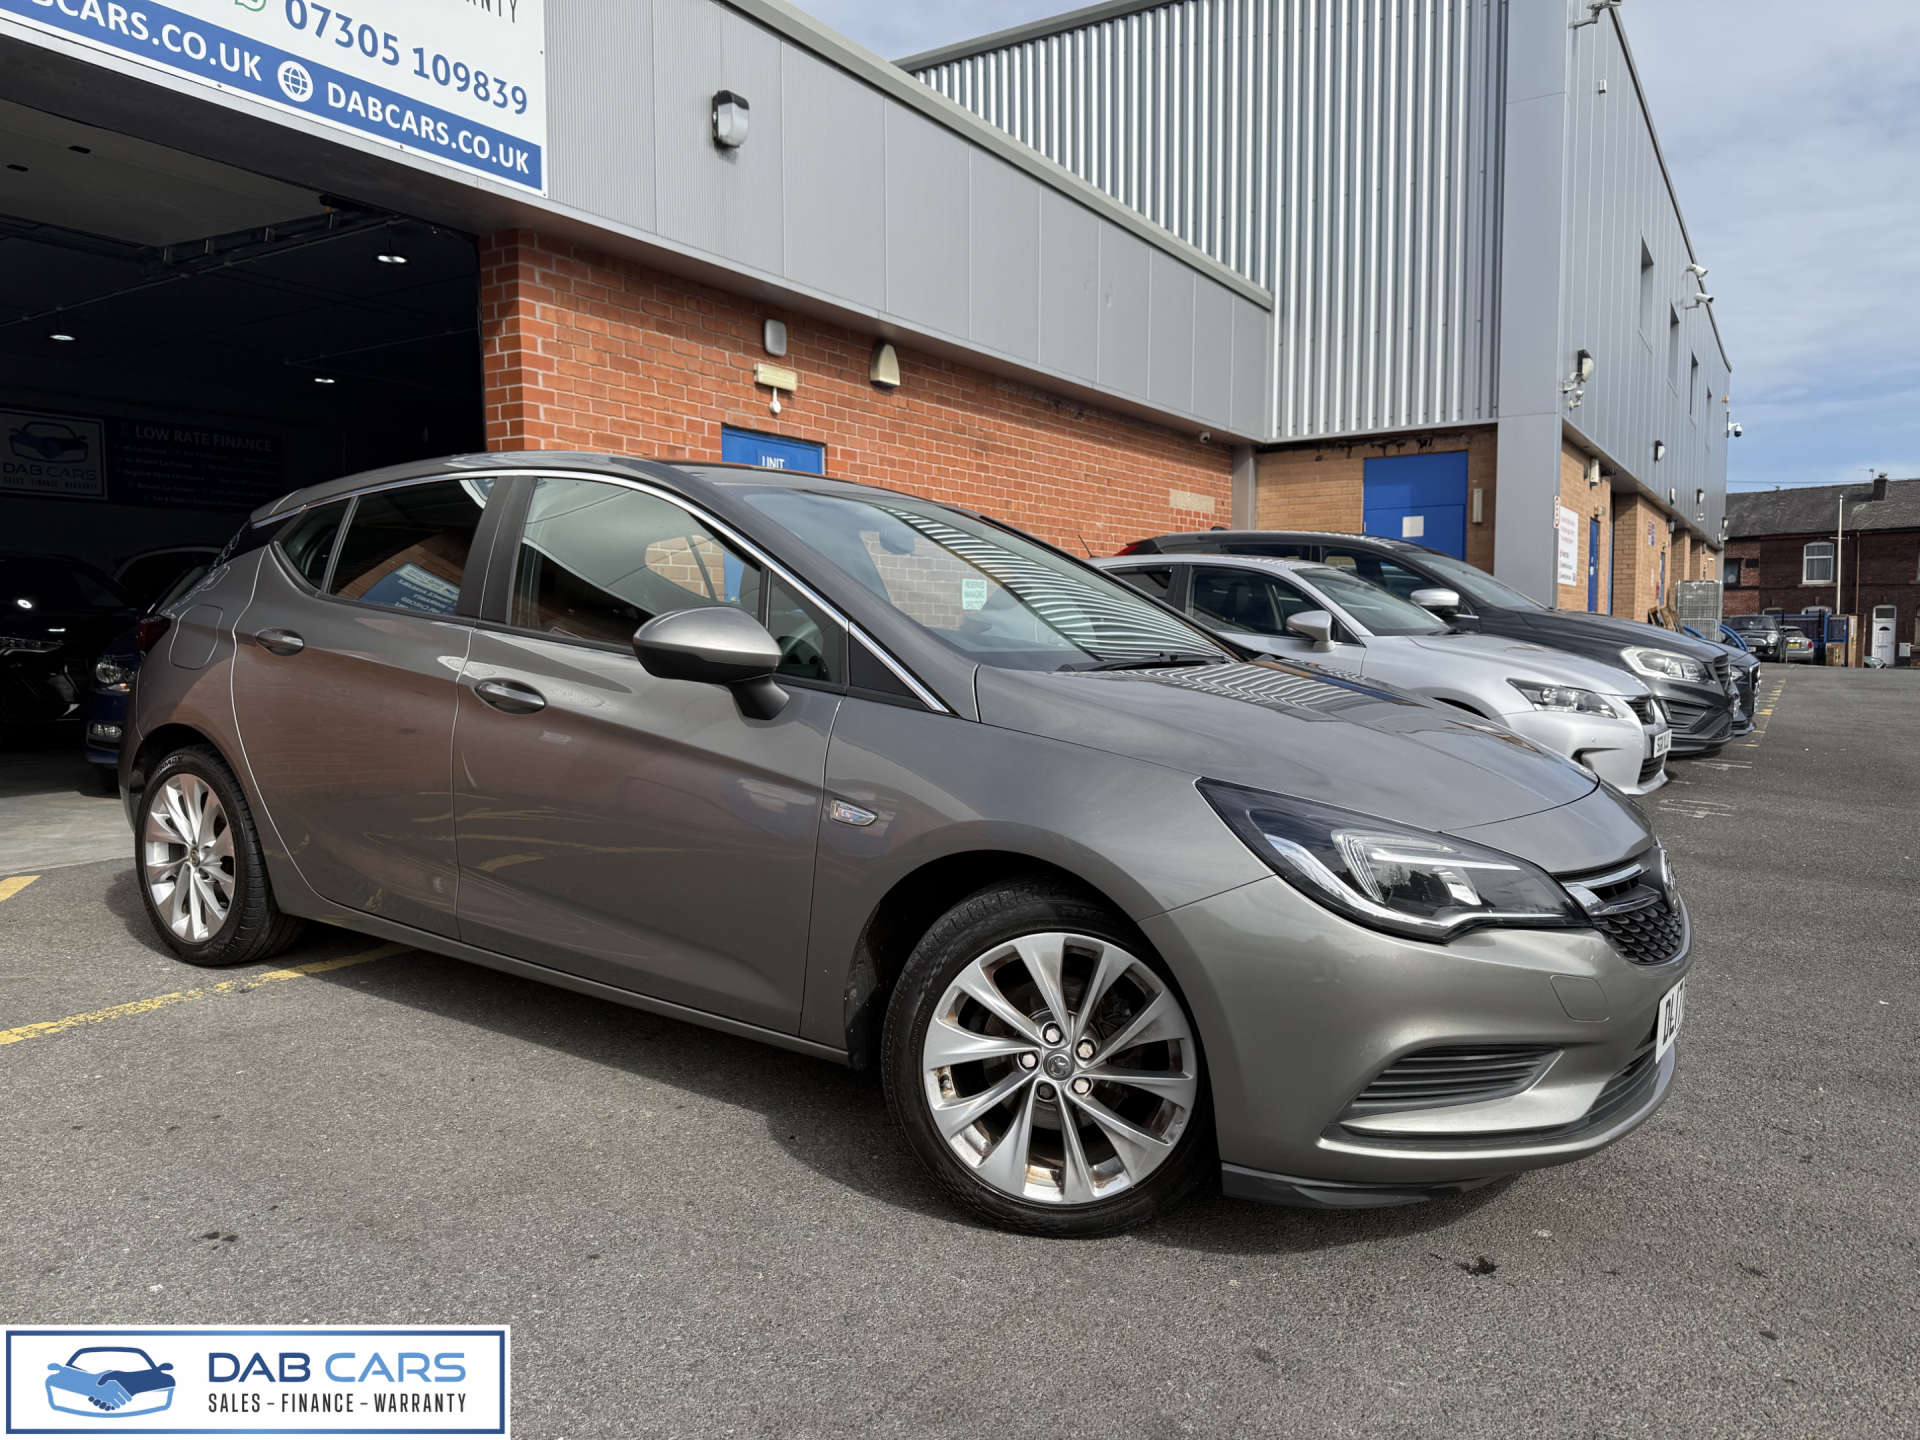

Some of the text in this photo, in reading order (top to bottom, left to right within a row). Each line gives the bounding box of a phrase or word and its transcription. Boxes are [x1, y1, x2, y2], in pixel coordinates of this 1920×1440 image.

[32, 0, 262, 81] CARS.CO.UK
[284, 0, 528, 115] 07305 109839
[326, 80, 530, 174] DABCARS.CO.UK
[3, 462, 97, 480] DAB CARS
[135, 424, 273, 452] LOW RATE FINANCE
